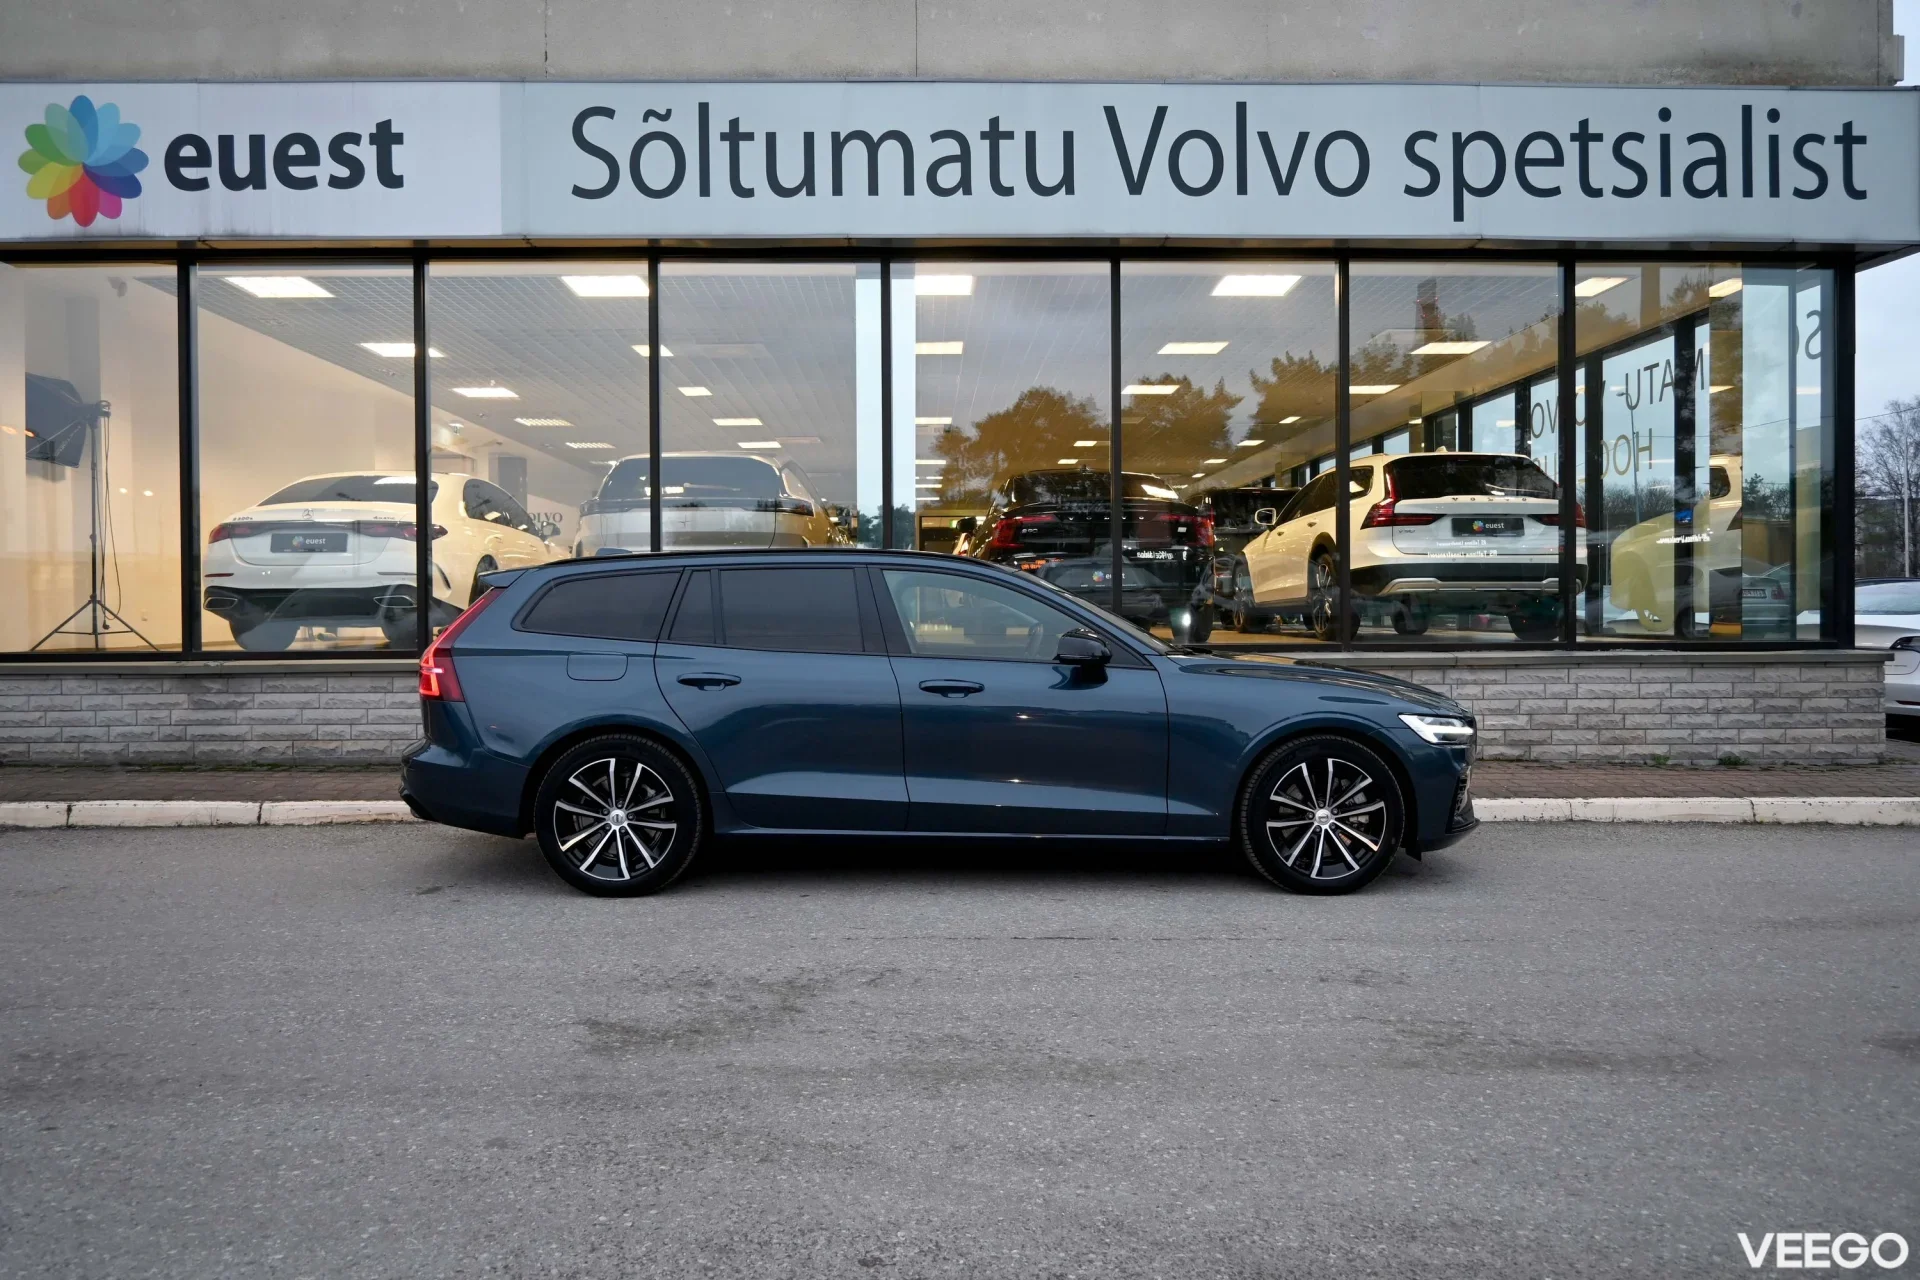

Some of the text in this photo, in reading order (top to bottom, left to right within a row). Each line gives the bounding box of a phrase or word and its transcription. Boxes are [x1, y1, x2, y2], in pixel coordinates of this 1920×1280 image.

[163, 118, 404, 192] euest
[571, 101, 1868, 223] Sõltumatu Volvo spetsialist
[305, 537, 326, 545] euest
